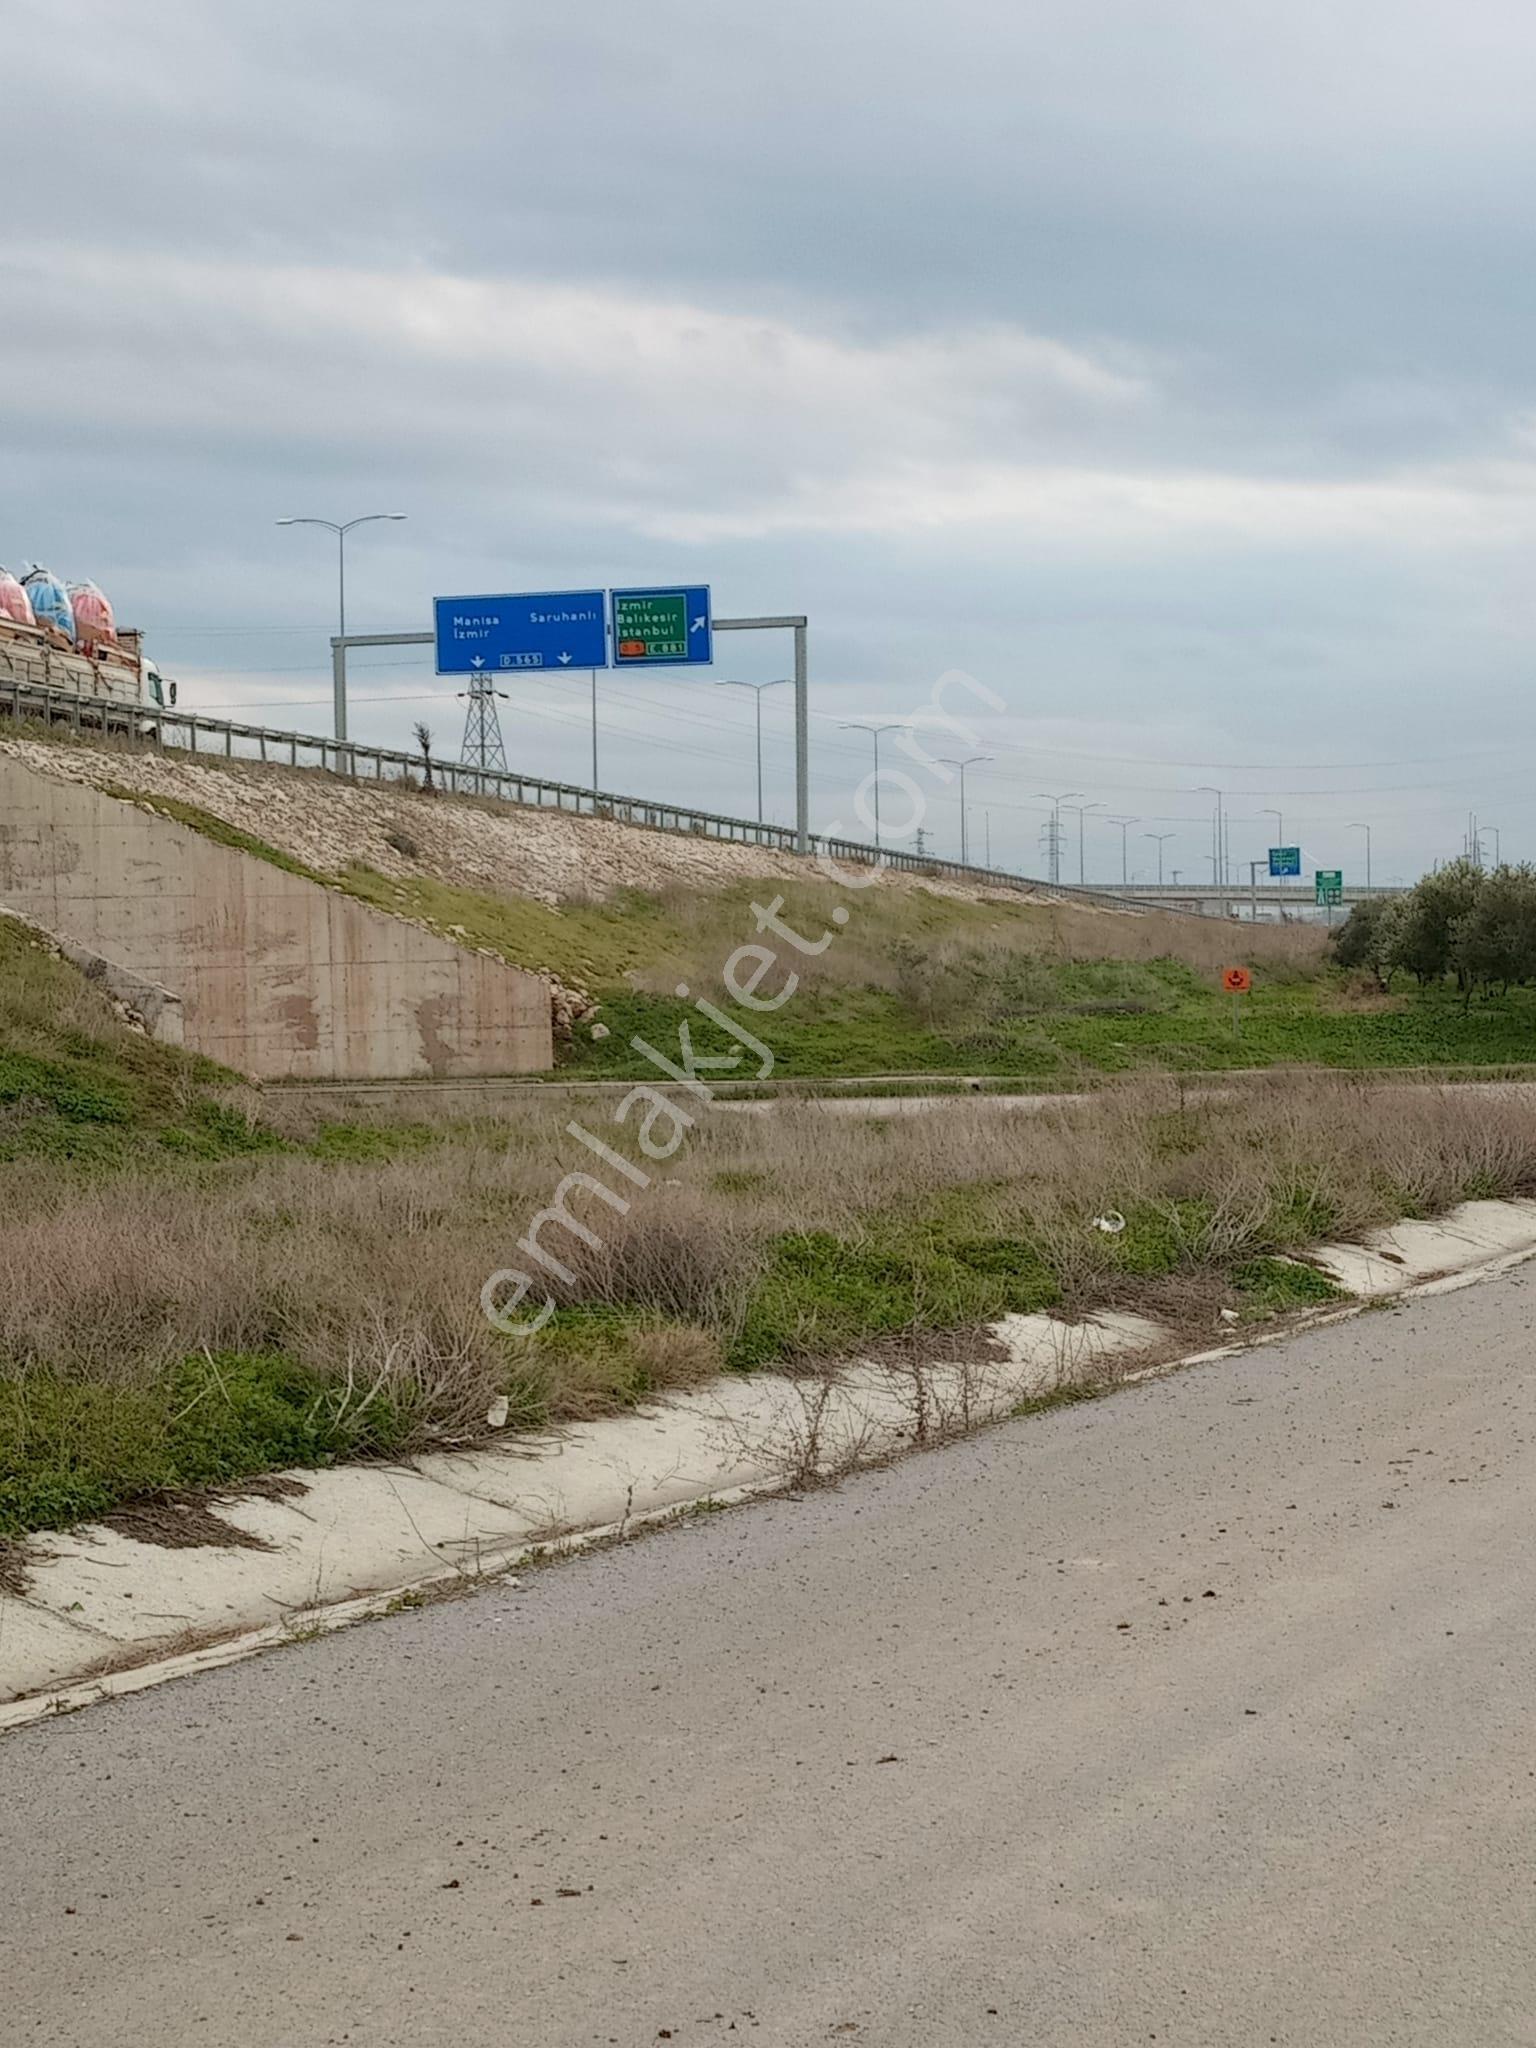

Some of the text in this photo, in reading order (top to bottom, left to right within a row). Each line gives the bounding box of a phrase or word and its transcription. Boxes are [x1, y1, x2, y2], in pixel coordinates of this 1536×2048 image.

[453, 610, 597, 626] Manisa Saruhanlı
[617, 613, 678, 624] Balıkesir
